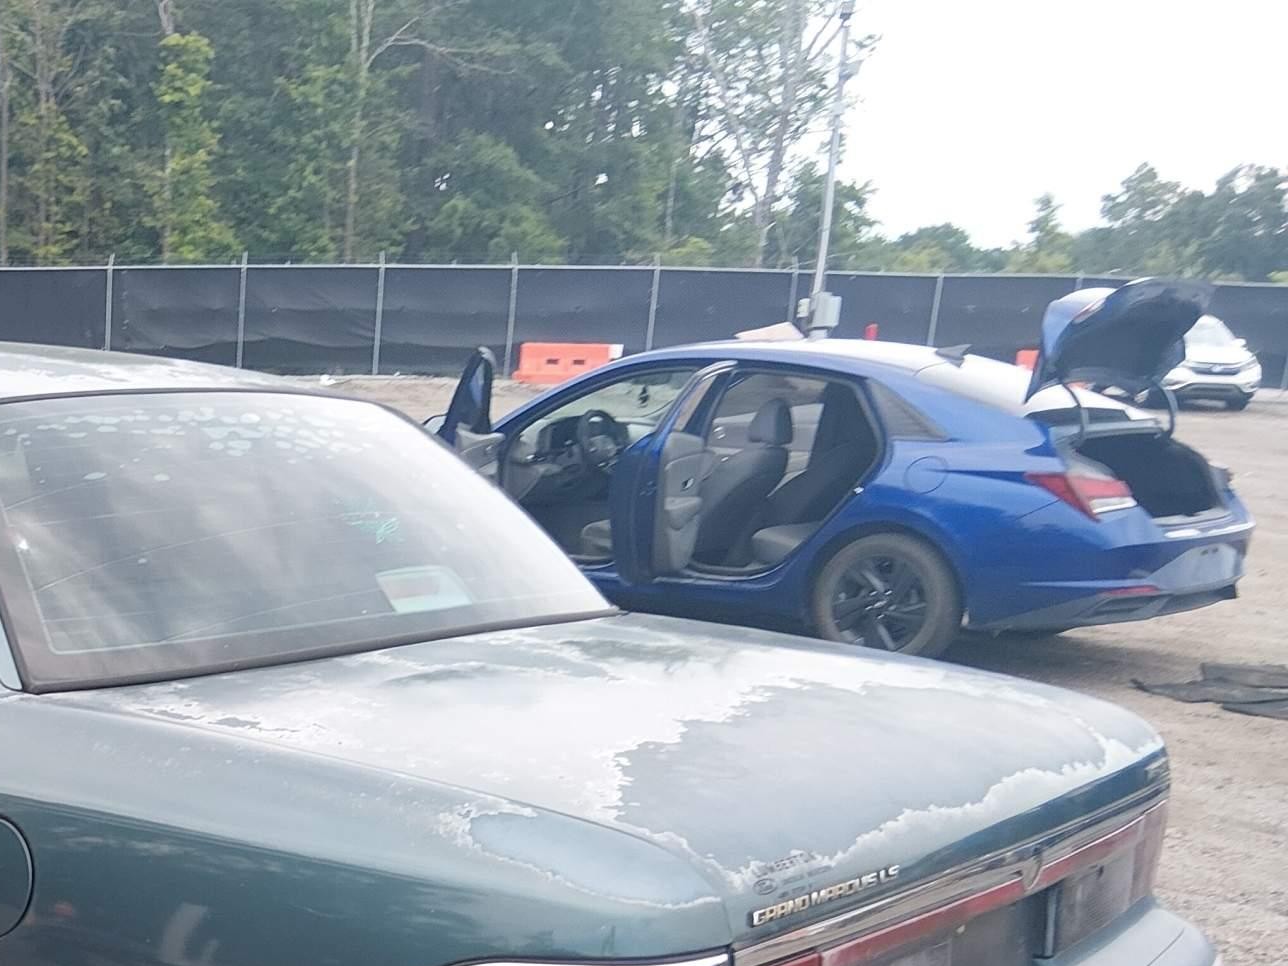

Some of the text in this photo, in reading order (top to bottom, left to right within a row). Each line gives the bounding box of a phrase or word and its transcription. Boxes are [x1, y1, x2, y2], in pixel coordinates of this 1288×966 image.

[752, 892, 810, 926] GRAND
[811, 872, 878, 905] MARQUIS
[879, 864, 901, 882] LS
